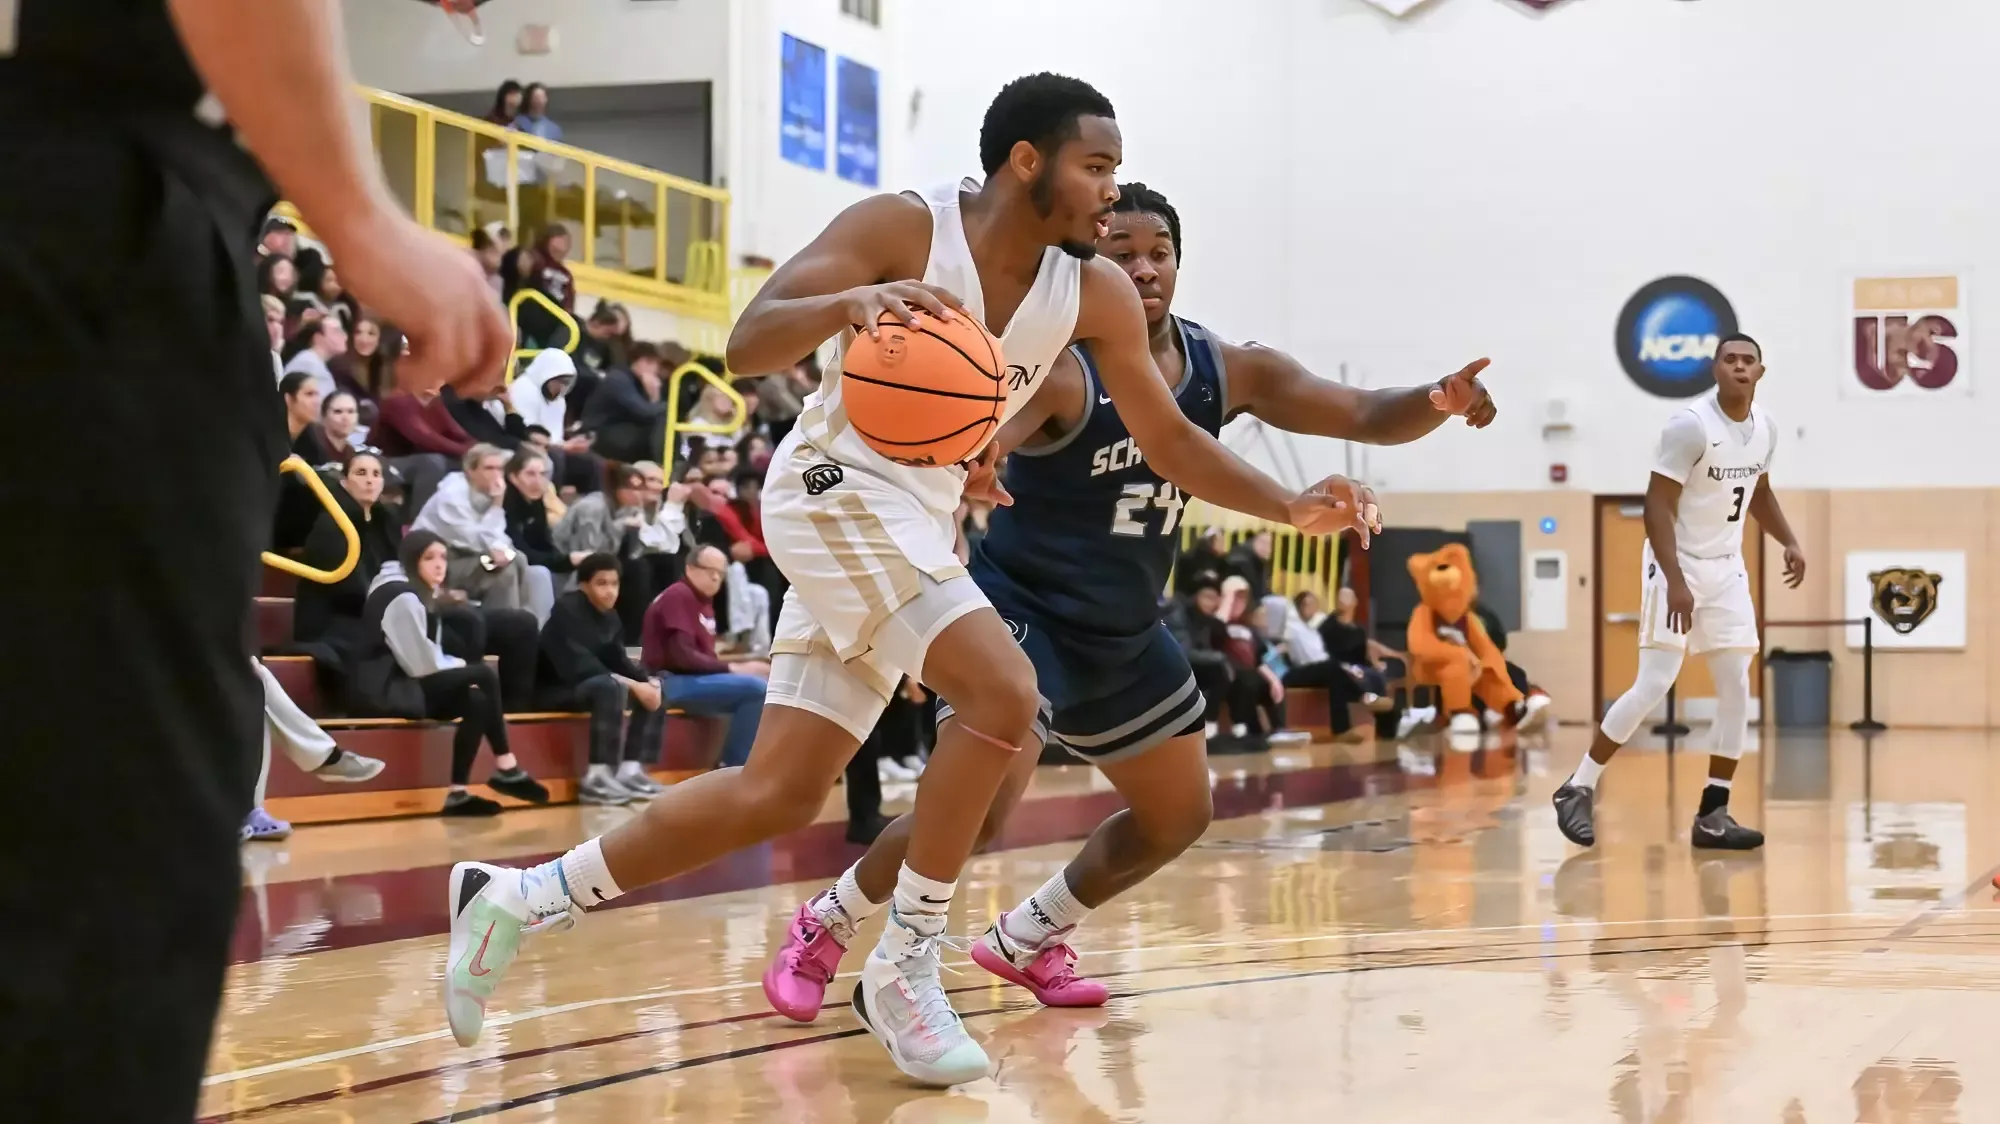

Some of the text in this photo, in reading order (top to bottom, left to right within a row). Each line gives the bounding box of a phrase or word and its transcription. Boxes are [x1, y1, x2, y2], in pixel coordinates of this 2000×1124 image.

[1639, 334, 1720, 361] NCAA
[1854, 315, 1958, 390] US
[1110, 481, 1184, 537] 24
[1727, 486, 1745, 522] 3
